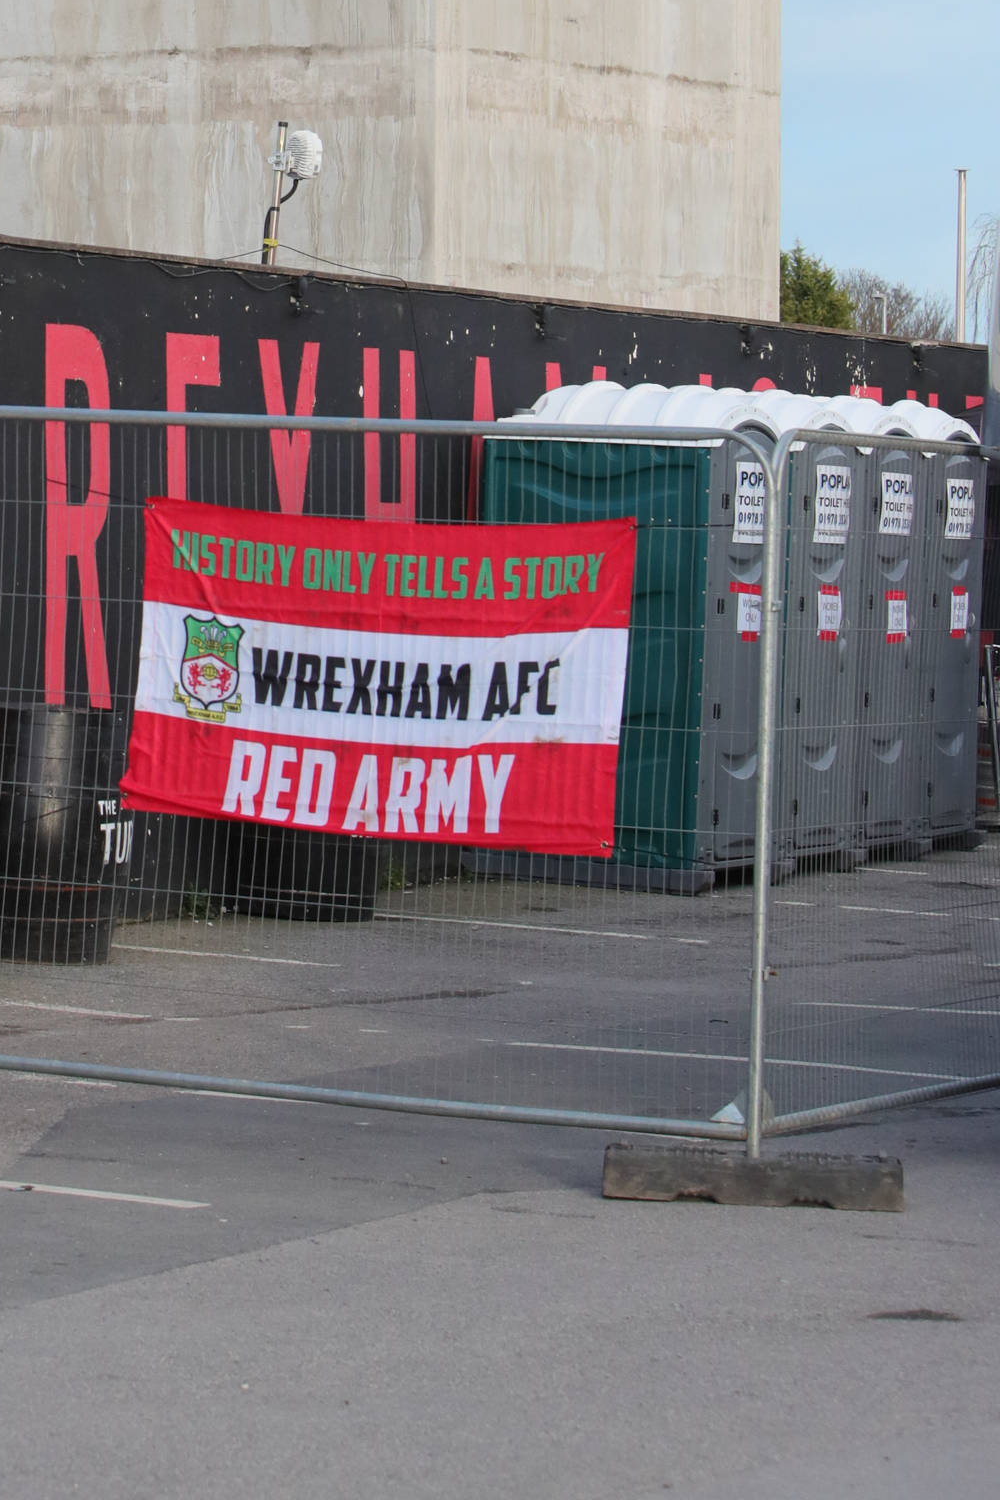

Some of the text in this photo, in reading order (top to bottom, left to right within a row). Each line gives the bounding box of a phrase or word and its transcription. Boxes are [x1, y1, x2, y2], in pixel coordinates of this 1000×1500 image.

[739, 495, 764, 507] TOILET
[819, 497, 843, 508] TOILET
[885, 502, 906, 512] TOILET
[950, 507, 969, 517] TOILET
[171, 529, 605, 600] HISTORY ONLY TELLS A STORY
[252, 647, 560, 721] WREXHAM AFC
[220, 739, 515, 834] RED ARMY
[98, 800, 117, 816] THE
